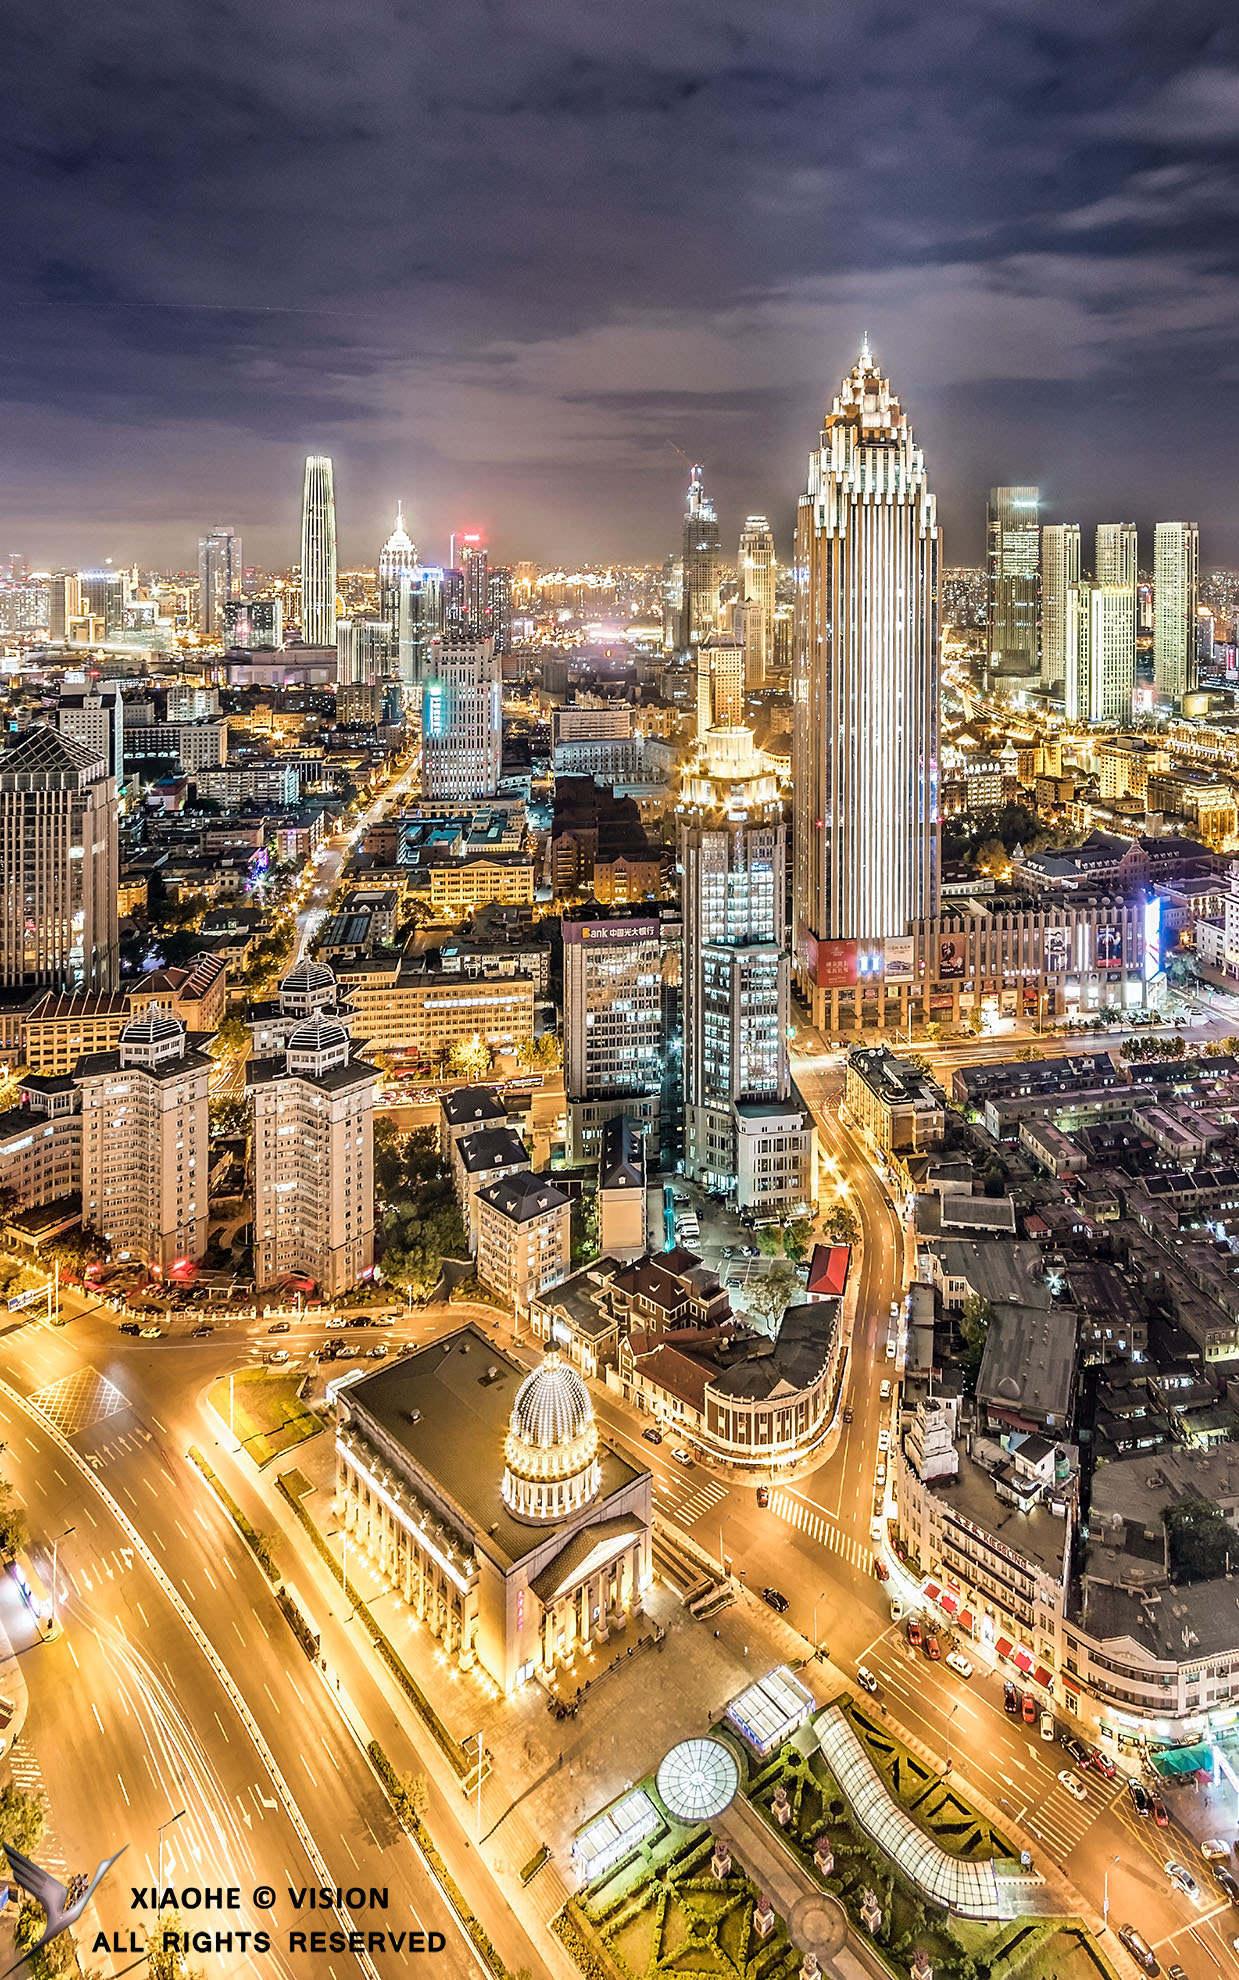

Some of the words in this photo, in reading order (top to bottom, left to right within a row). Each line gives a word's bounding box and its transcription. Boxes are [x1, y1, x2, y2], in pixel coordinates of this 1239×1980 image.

[582, 927, 608, 939] Bank
[609, 926, 655, 937] 中国光大银行
[983, 1533, 1028, 1569] KIESSLING
